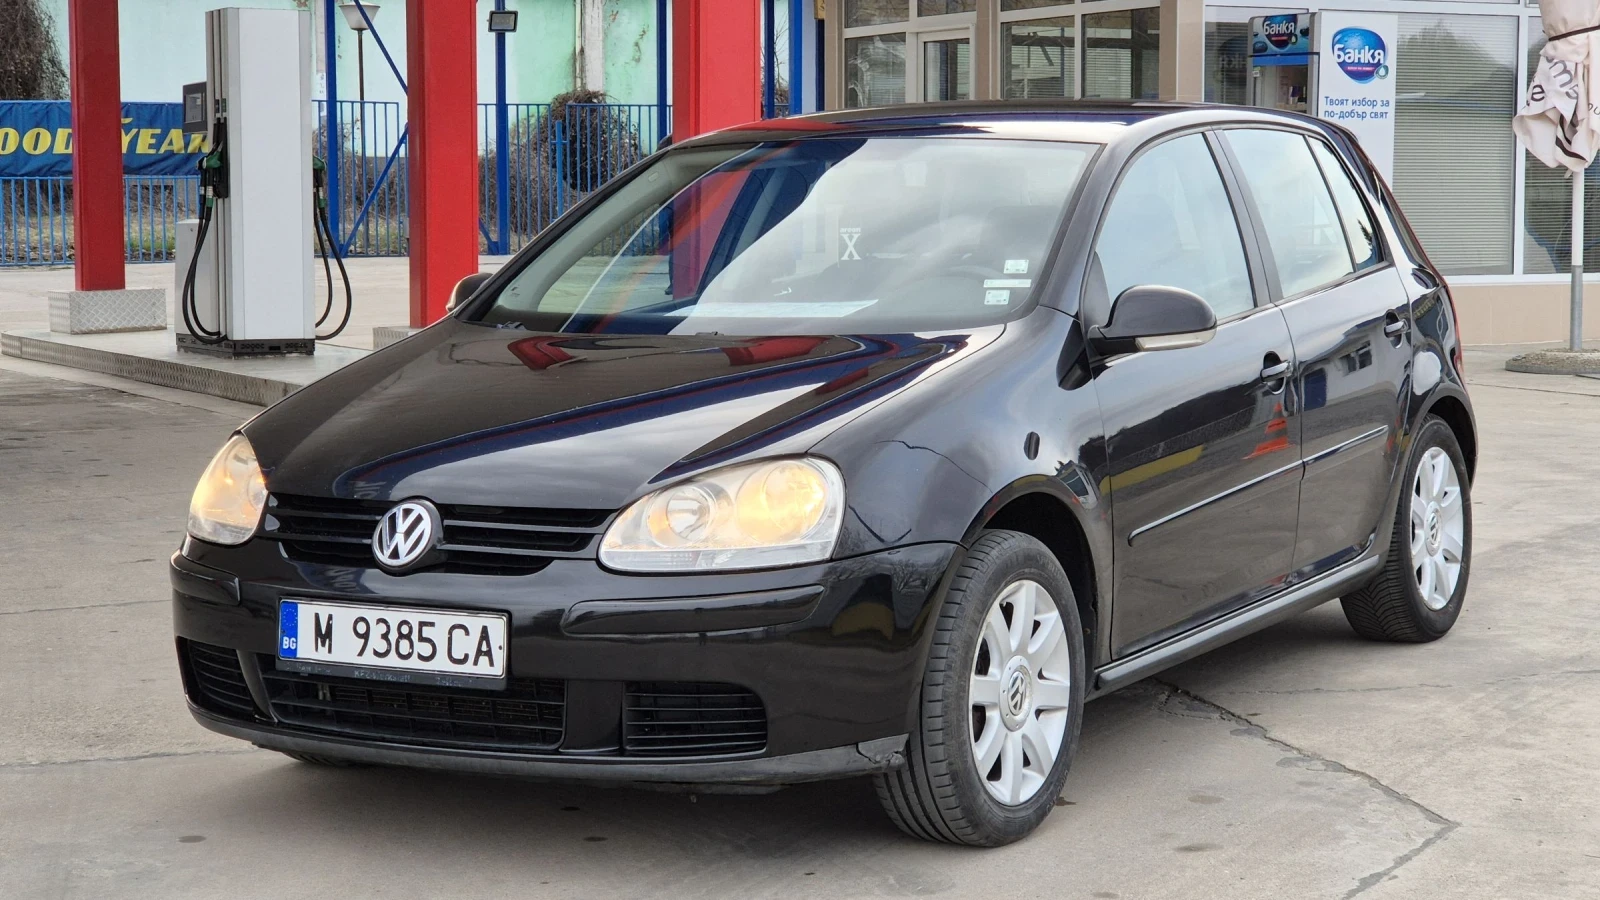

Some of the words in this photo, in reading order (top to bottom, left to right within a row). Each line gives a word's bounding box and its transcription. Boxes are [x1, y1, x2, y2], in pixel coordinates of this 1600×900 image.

[1324, 96, 1349, 106] Твоят
[1351, 97, 1378, 109] избор
[1380, 99, 1390, 107] за
[1324, 110, 1367, 120] по-добър
[1369, 111, 1388, 119] свят
[840, 233, 862, 260] X
[282, 637, 297, 650] BG
[314, 612, 333, 655] M
[352, 616, 437, 663] 9385
[447, 623, 495, 668] CA
